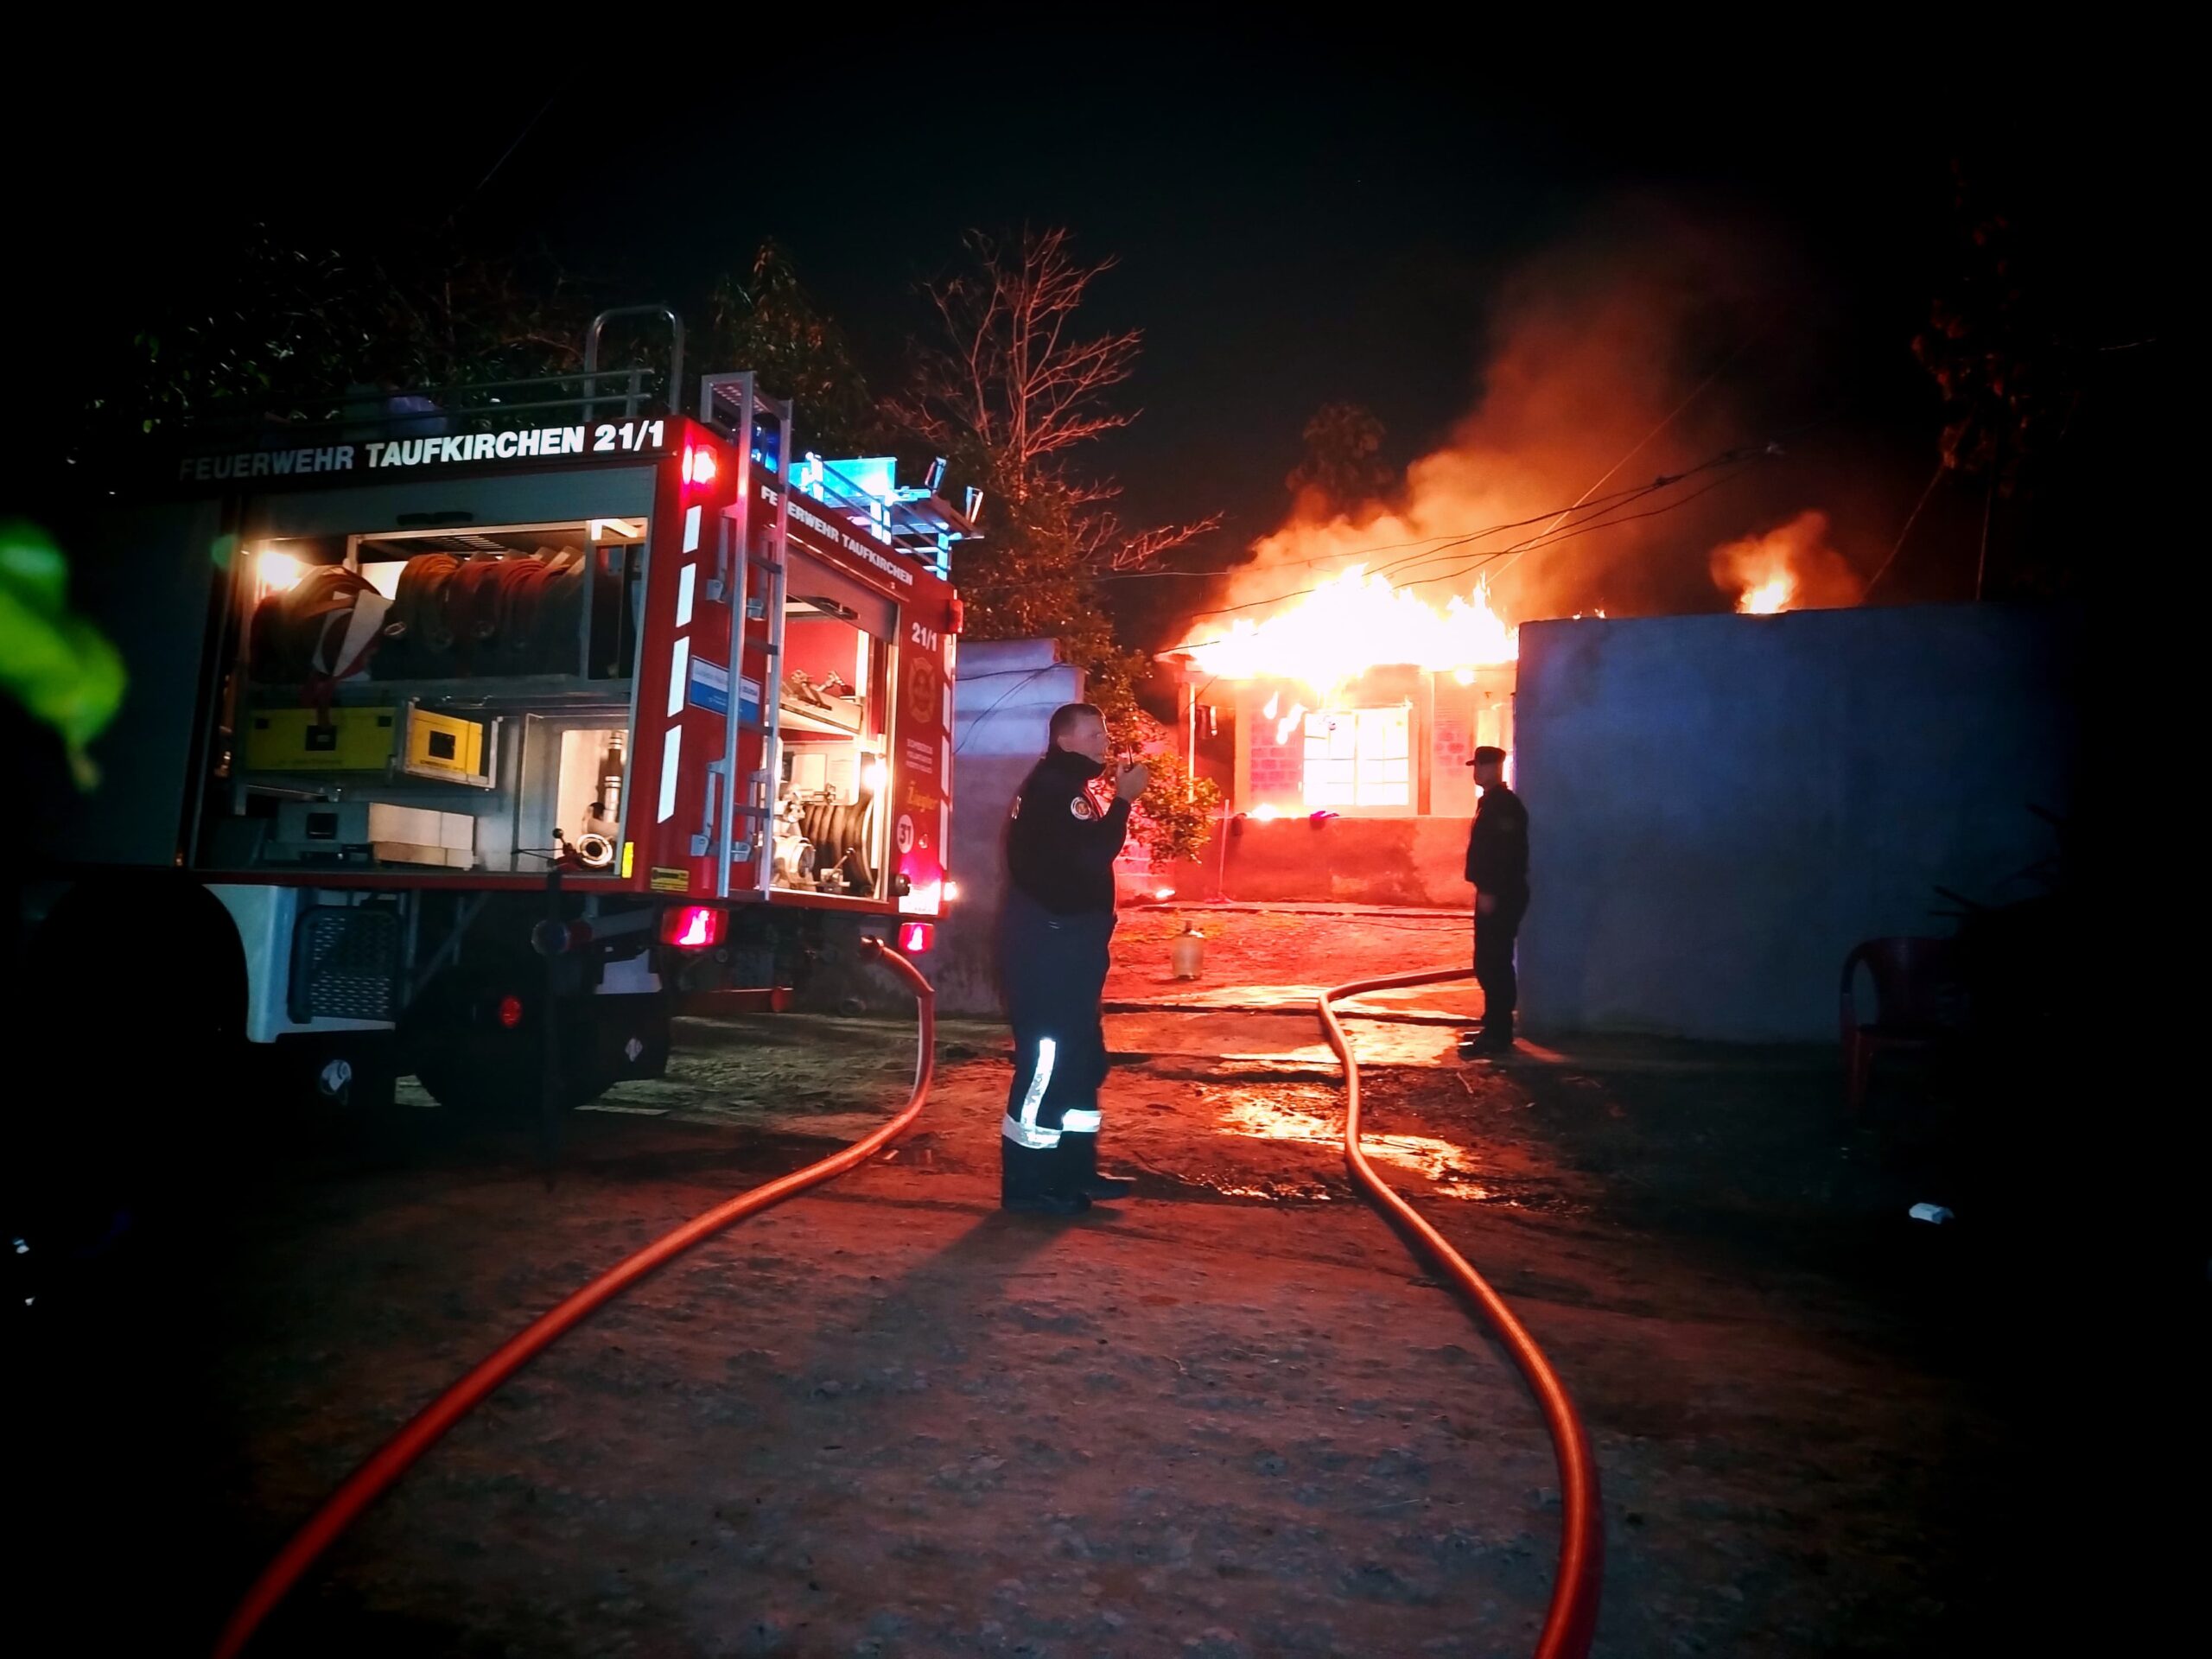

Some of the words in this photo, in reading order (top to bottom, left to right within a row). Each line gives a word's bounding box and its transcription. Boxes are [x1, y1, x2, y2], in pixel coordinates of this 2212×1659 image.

[178, 445, 355, 482] FEUERWEHR
[365, 427, 584, 467] TAUFKIRCHEN
[594, 421, 664, 451] 21/1
[761, 486, 839, 543] FEERWEHR
[842, 533, 913, 586] TAUFKIRCHEN
[912, 622, 938, 652] 21/1
